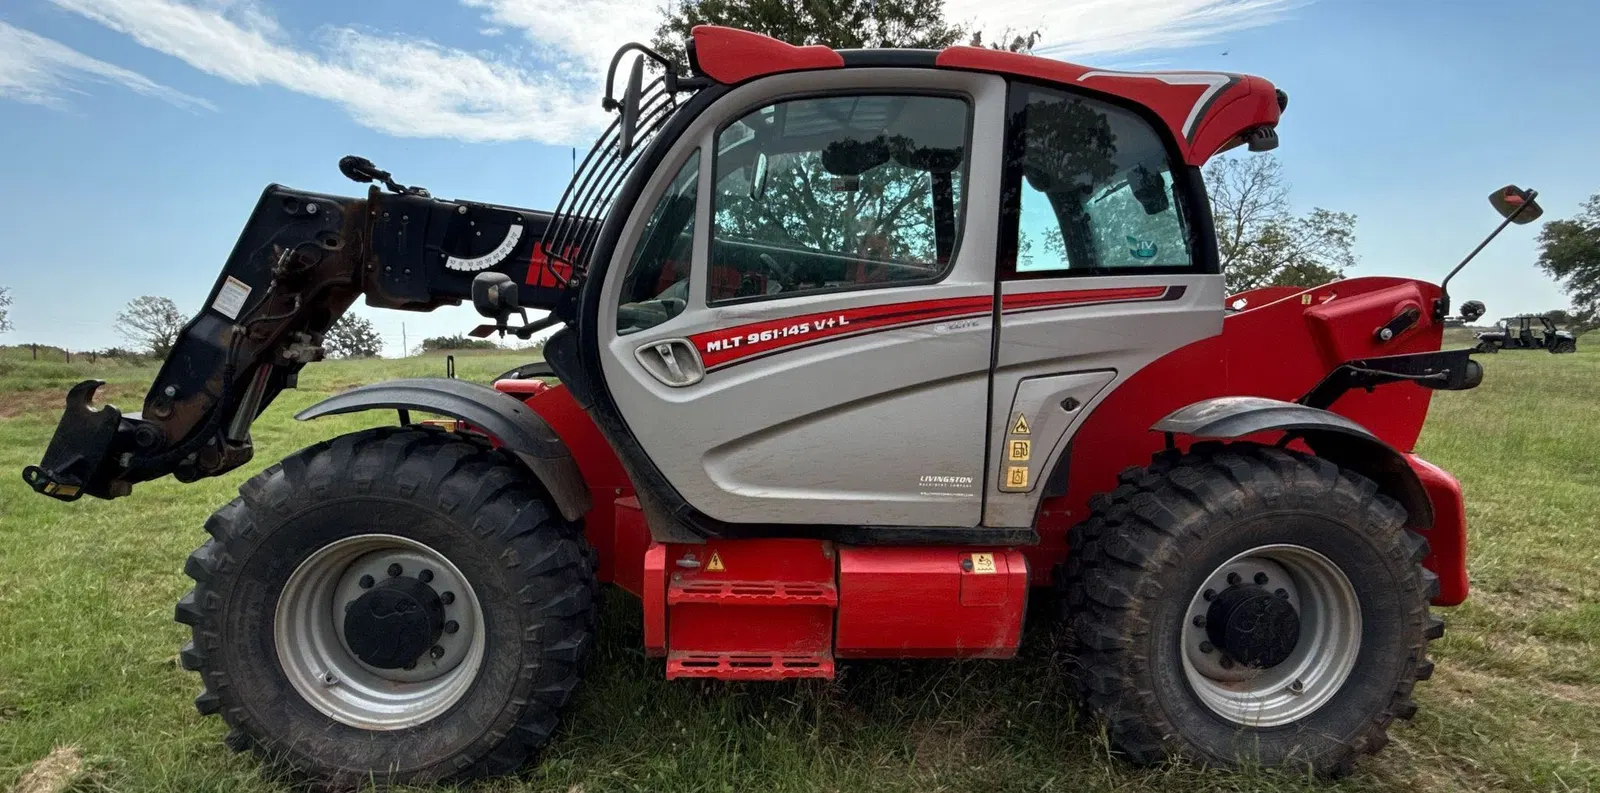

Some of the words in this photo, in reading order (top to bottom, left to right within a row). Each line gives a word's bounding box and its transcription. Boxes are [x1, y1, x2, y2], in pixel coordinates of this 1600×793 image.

[707, 336, 743, 353] MLT
[814, 317, 836, 331] V+
[839, 315, 849, 326] L
[920, 475, 974, 483] LIVINGSTON
